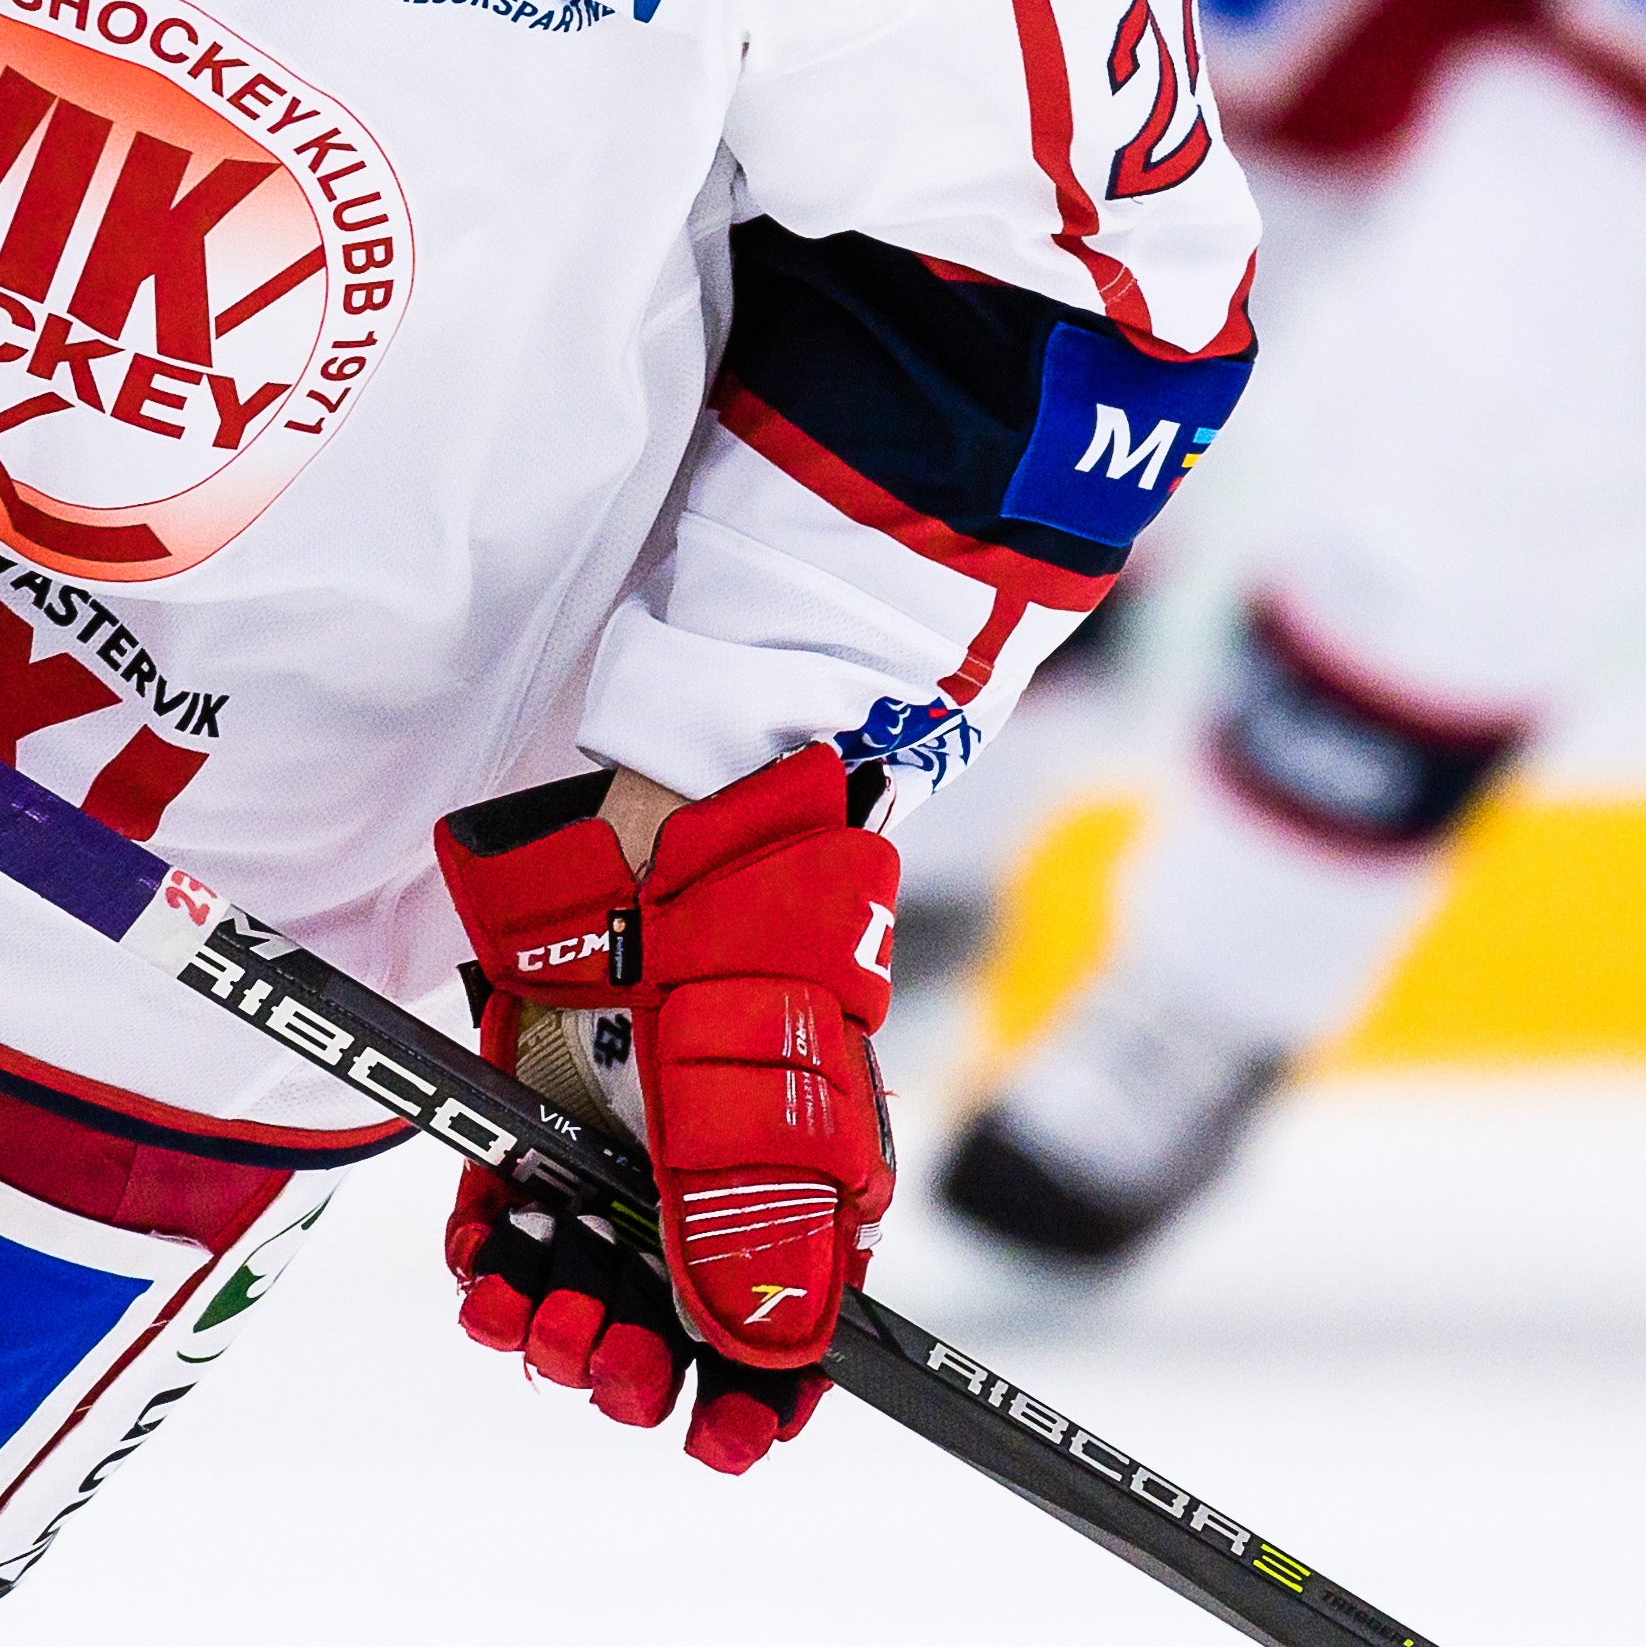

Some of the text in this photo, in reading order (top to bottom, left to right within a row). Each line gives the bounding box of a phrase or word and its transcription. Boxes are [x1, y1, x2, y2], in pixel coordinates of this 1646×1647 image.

[284, 330, 377, 435] 1971
[516, 929, 611, 974] CCM
[539, 1104, 582, 1142] VIK
[927, 1341, 1252, 1556] RIBCOR
